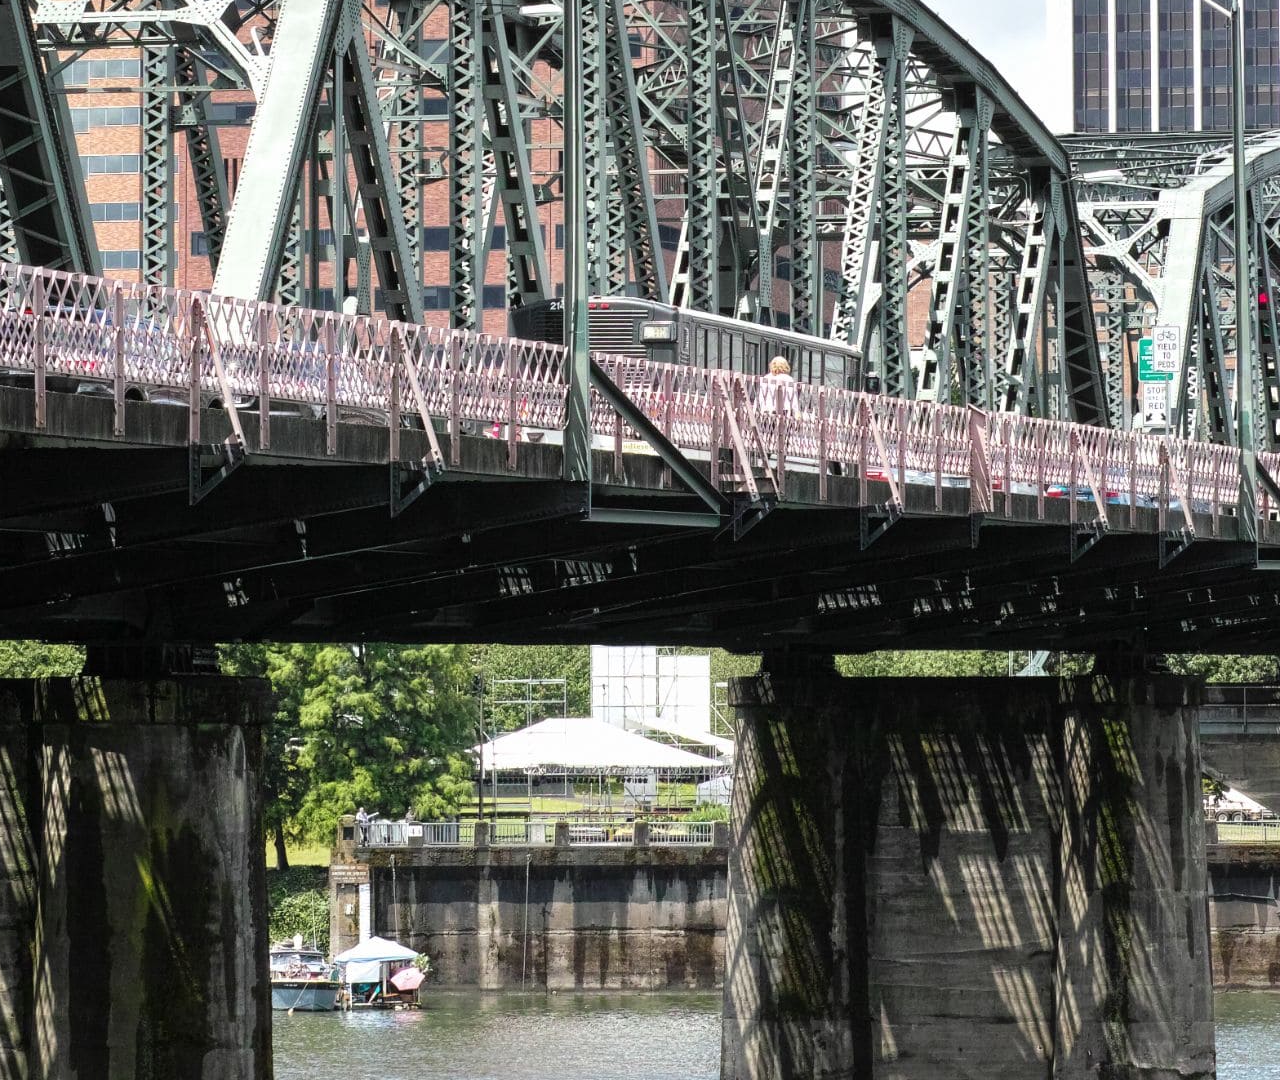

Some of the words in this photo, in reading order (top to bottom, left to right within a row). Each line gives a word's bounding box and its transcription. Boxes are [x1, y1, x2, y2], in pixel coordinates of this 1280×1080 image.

[1157, 343, 1177, 351] YIELD
[1163, 351, 1171, 359] TO
[1157, 361, 1176, 369] PEDS
[1148, 402, 1165, 410] RED
